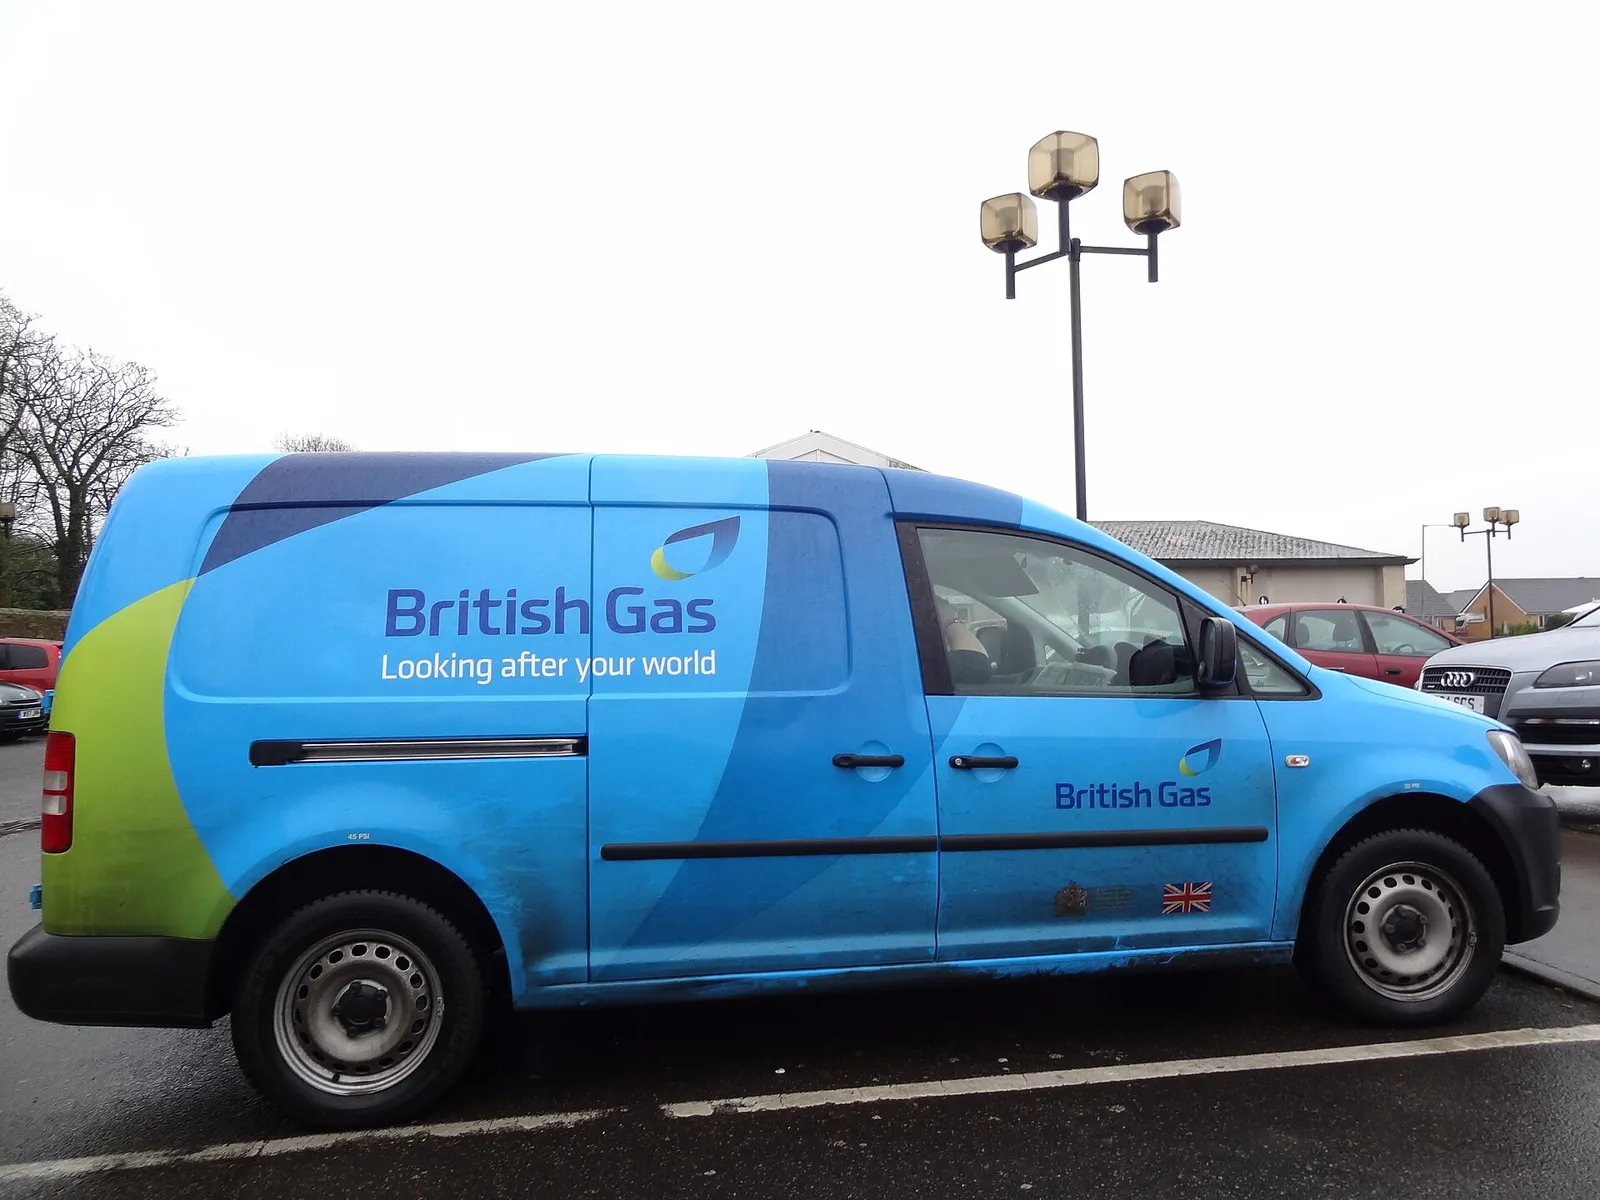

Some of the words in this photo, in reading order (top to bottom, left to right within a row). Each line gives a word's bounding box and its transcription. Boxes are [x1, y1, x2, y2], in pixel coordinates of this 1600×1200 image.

[384, 586, 590, 638] British
[605, 586, 717, 635] Gas
[381, 652, 493, 685] Looking
[501, 650, 567, 678] after
[575, 656, 636, 684] your
[643, 649, 716, 676] world
[1055, 781, 1152, 810] British
[1158, 781, 1212, 808] Gas
[358, 832, 370, 840] PSI
